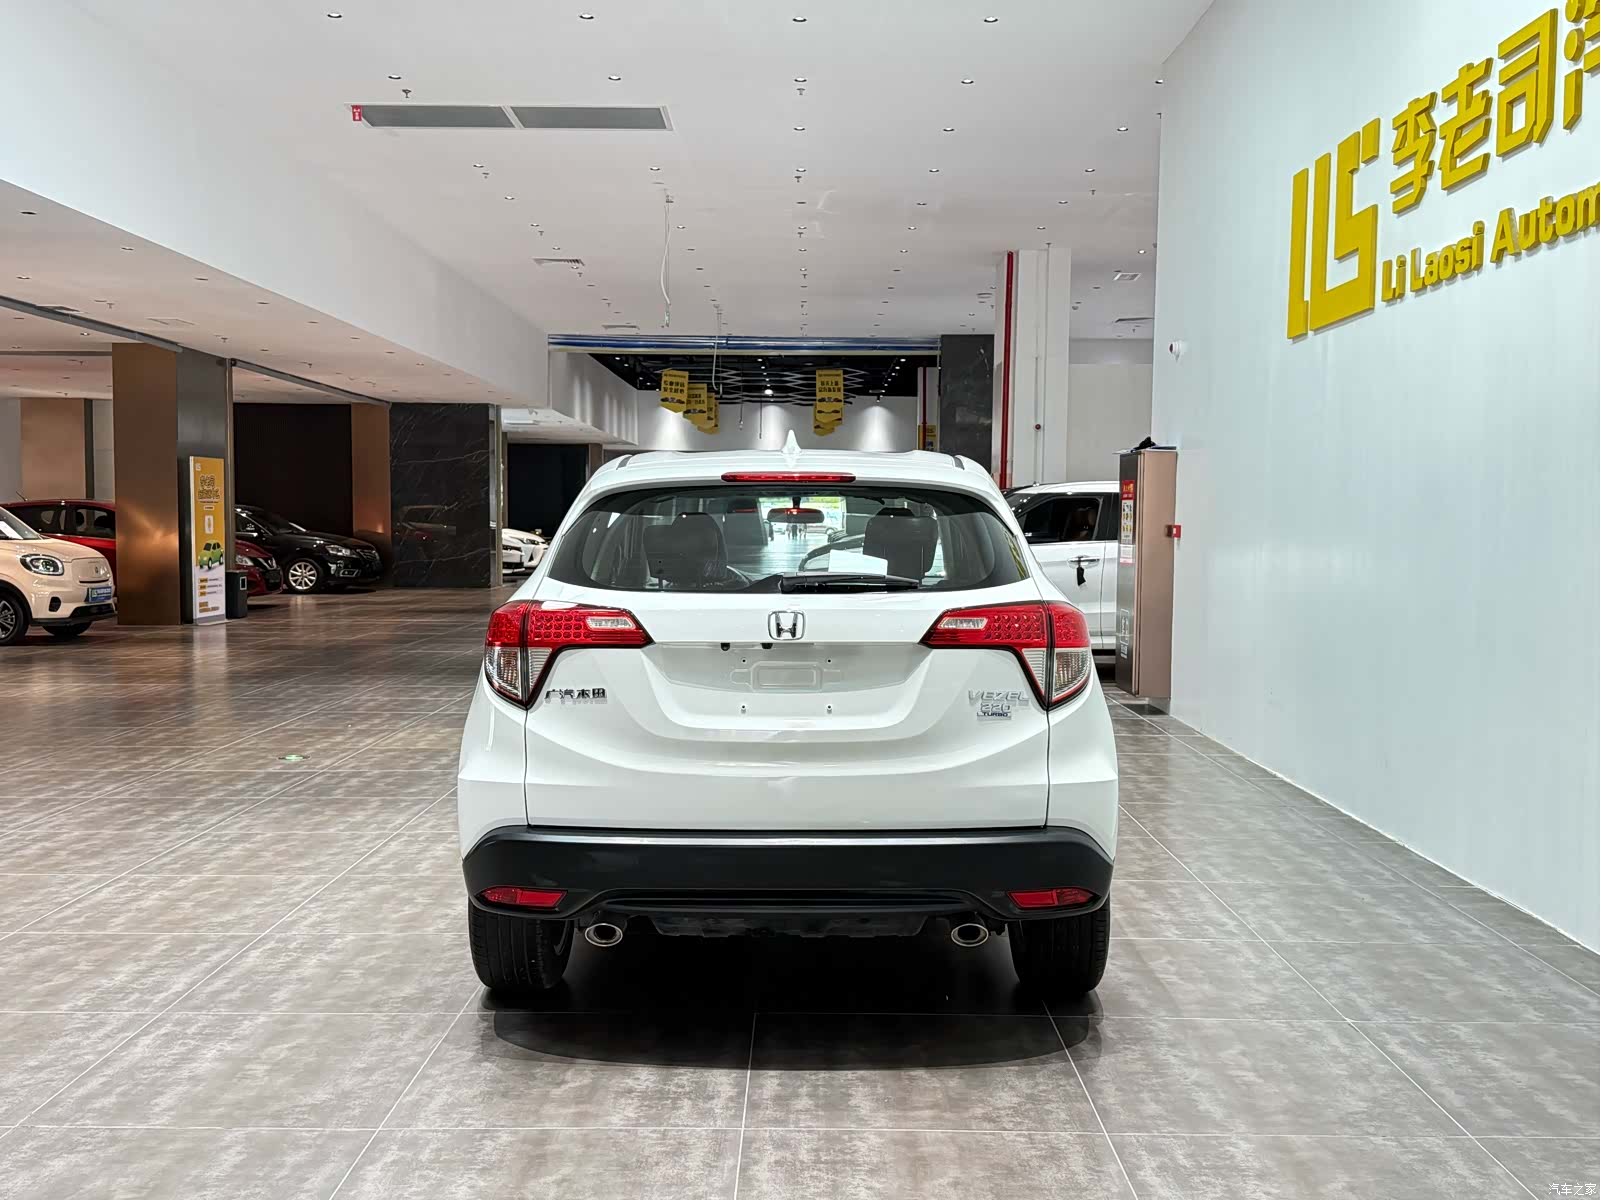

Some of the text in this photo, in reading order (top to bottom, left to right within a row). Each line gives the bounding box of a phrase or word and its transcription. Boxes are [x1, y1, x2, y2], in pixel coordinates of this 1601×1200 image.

[1381, 254, 1407, 302] Li
[1410, 220, 1485, 292] Laosi
[544, 687, 607, 700] 广汽本田
[968, 690, 1029, 703] VEZEL
[980, 702, 1011, 713] 220
